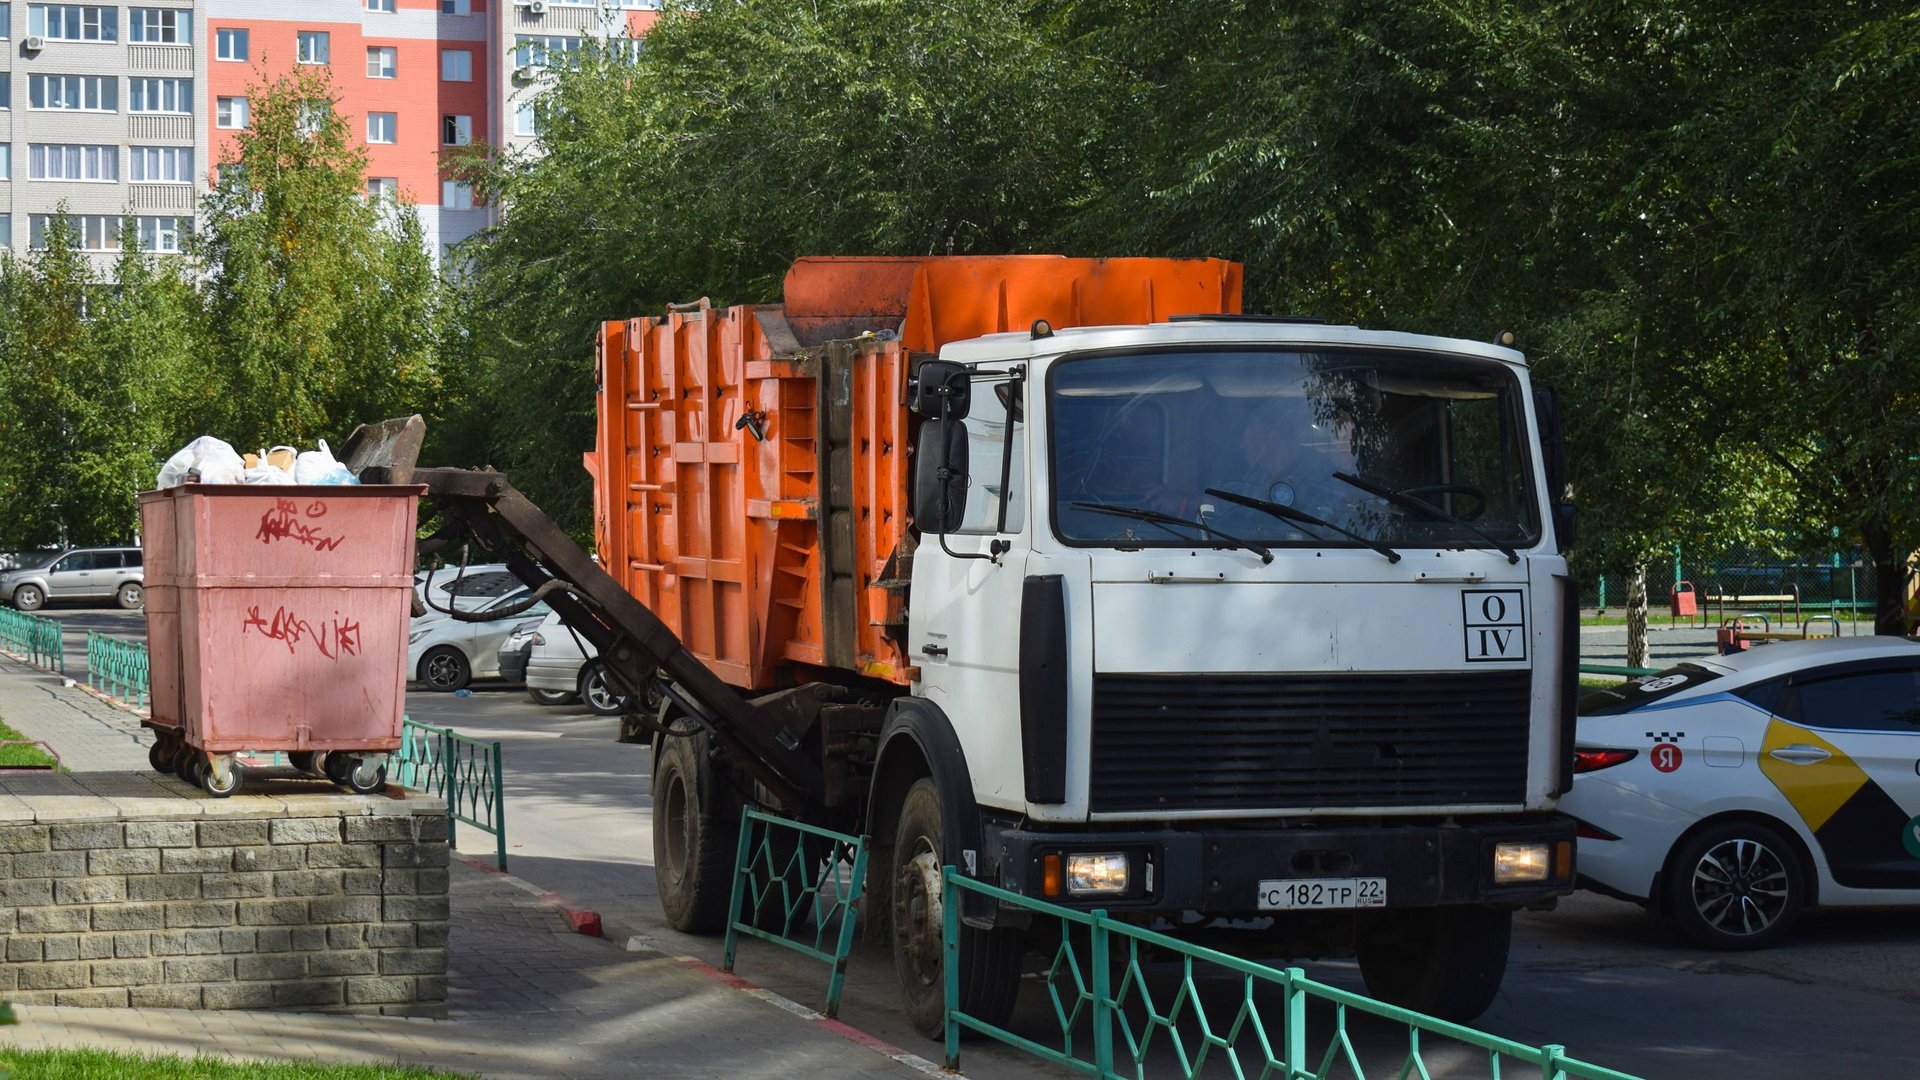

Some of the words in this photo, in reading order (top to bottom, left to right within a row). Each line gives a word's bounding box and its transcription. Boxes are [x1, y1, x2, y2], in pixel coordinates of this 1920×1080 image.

[1477, 629, 1513, 656] IV
[1659, 747, 1673, 768] Я
[1359, 881, 1379, 898] 22
